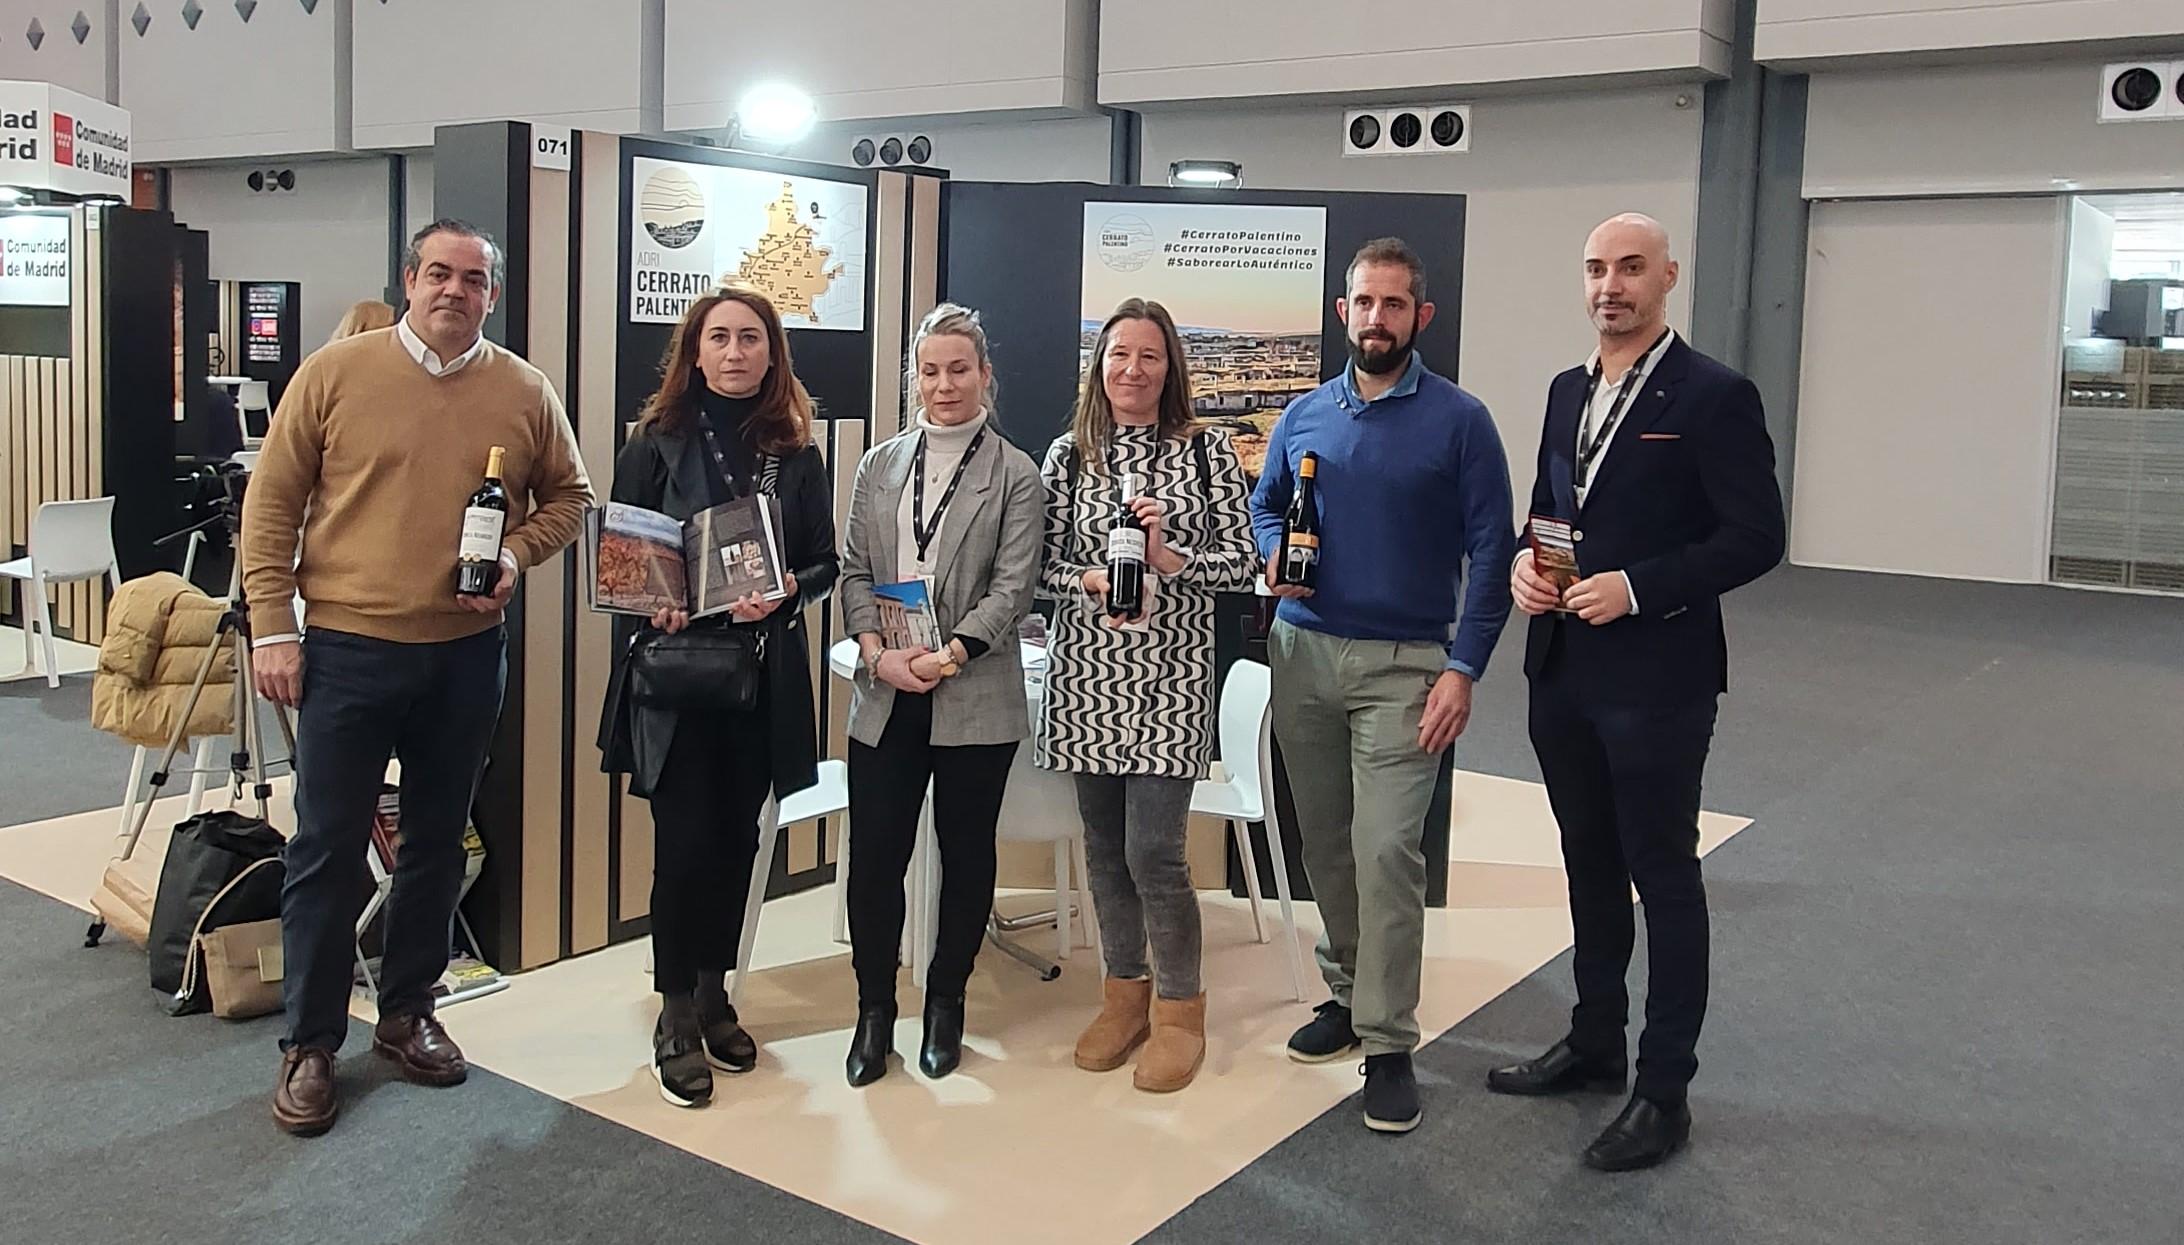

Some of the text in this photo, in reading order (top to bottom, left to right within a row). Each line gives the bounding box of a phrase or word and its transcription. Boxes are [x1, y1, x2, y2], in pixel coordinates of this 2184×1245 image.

[0, 108, 37, 129] ad
[76, 120, 128, 152] Comunidad
[538, 138, 567, 155] 071
[76, 149, 128, 179] de Madrid
[1181, 230, 1301, 241] #CerratoPalentino
[7, 239, 66, 253] Comunidad
[1164, 243, 1317, 256] #CerratoPorVacaciones
[637, 251, 660, 267] ADRI
[1167, 257, 1313, 270] #SaborearLoAuténtico
[7, 260, 66, 277] de Madrid
[637, 270, 711, 294] CERRATO
[636, 296, 696, 316] PALENTI
